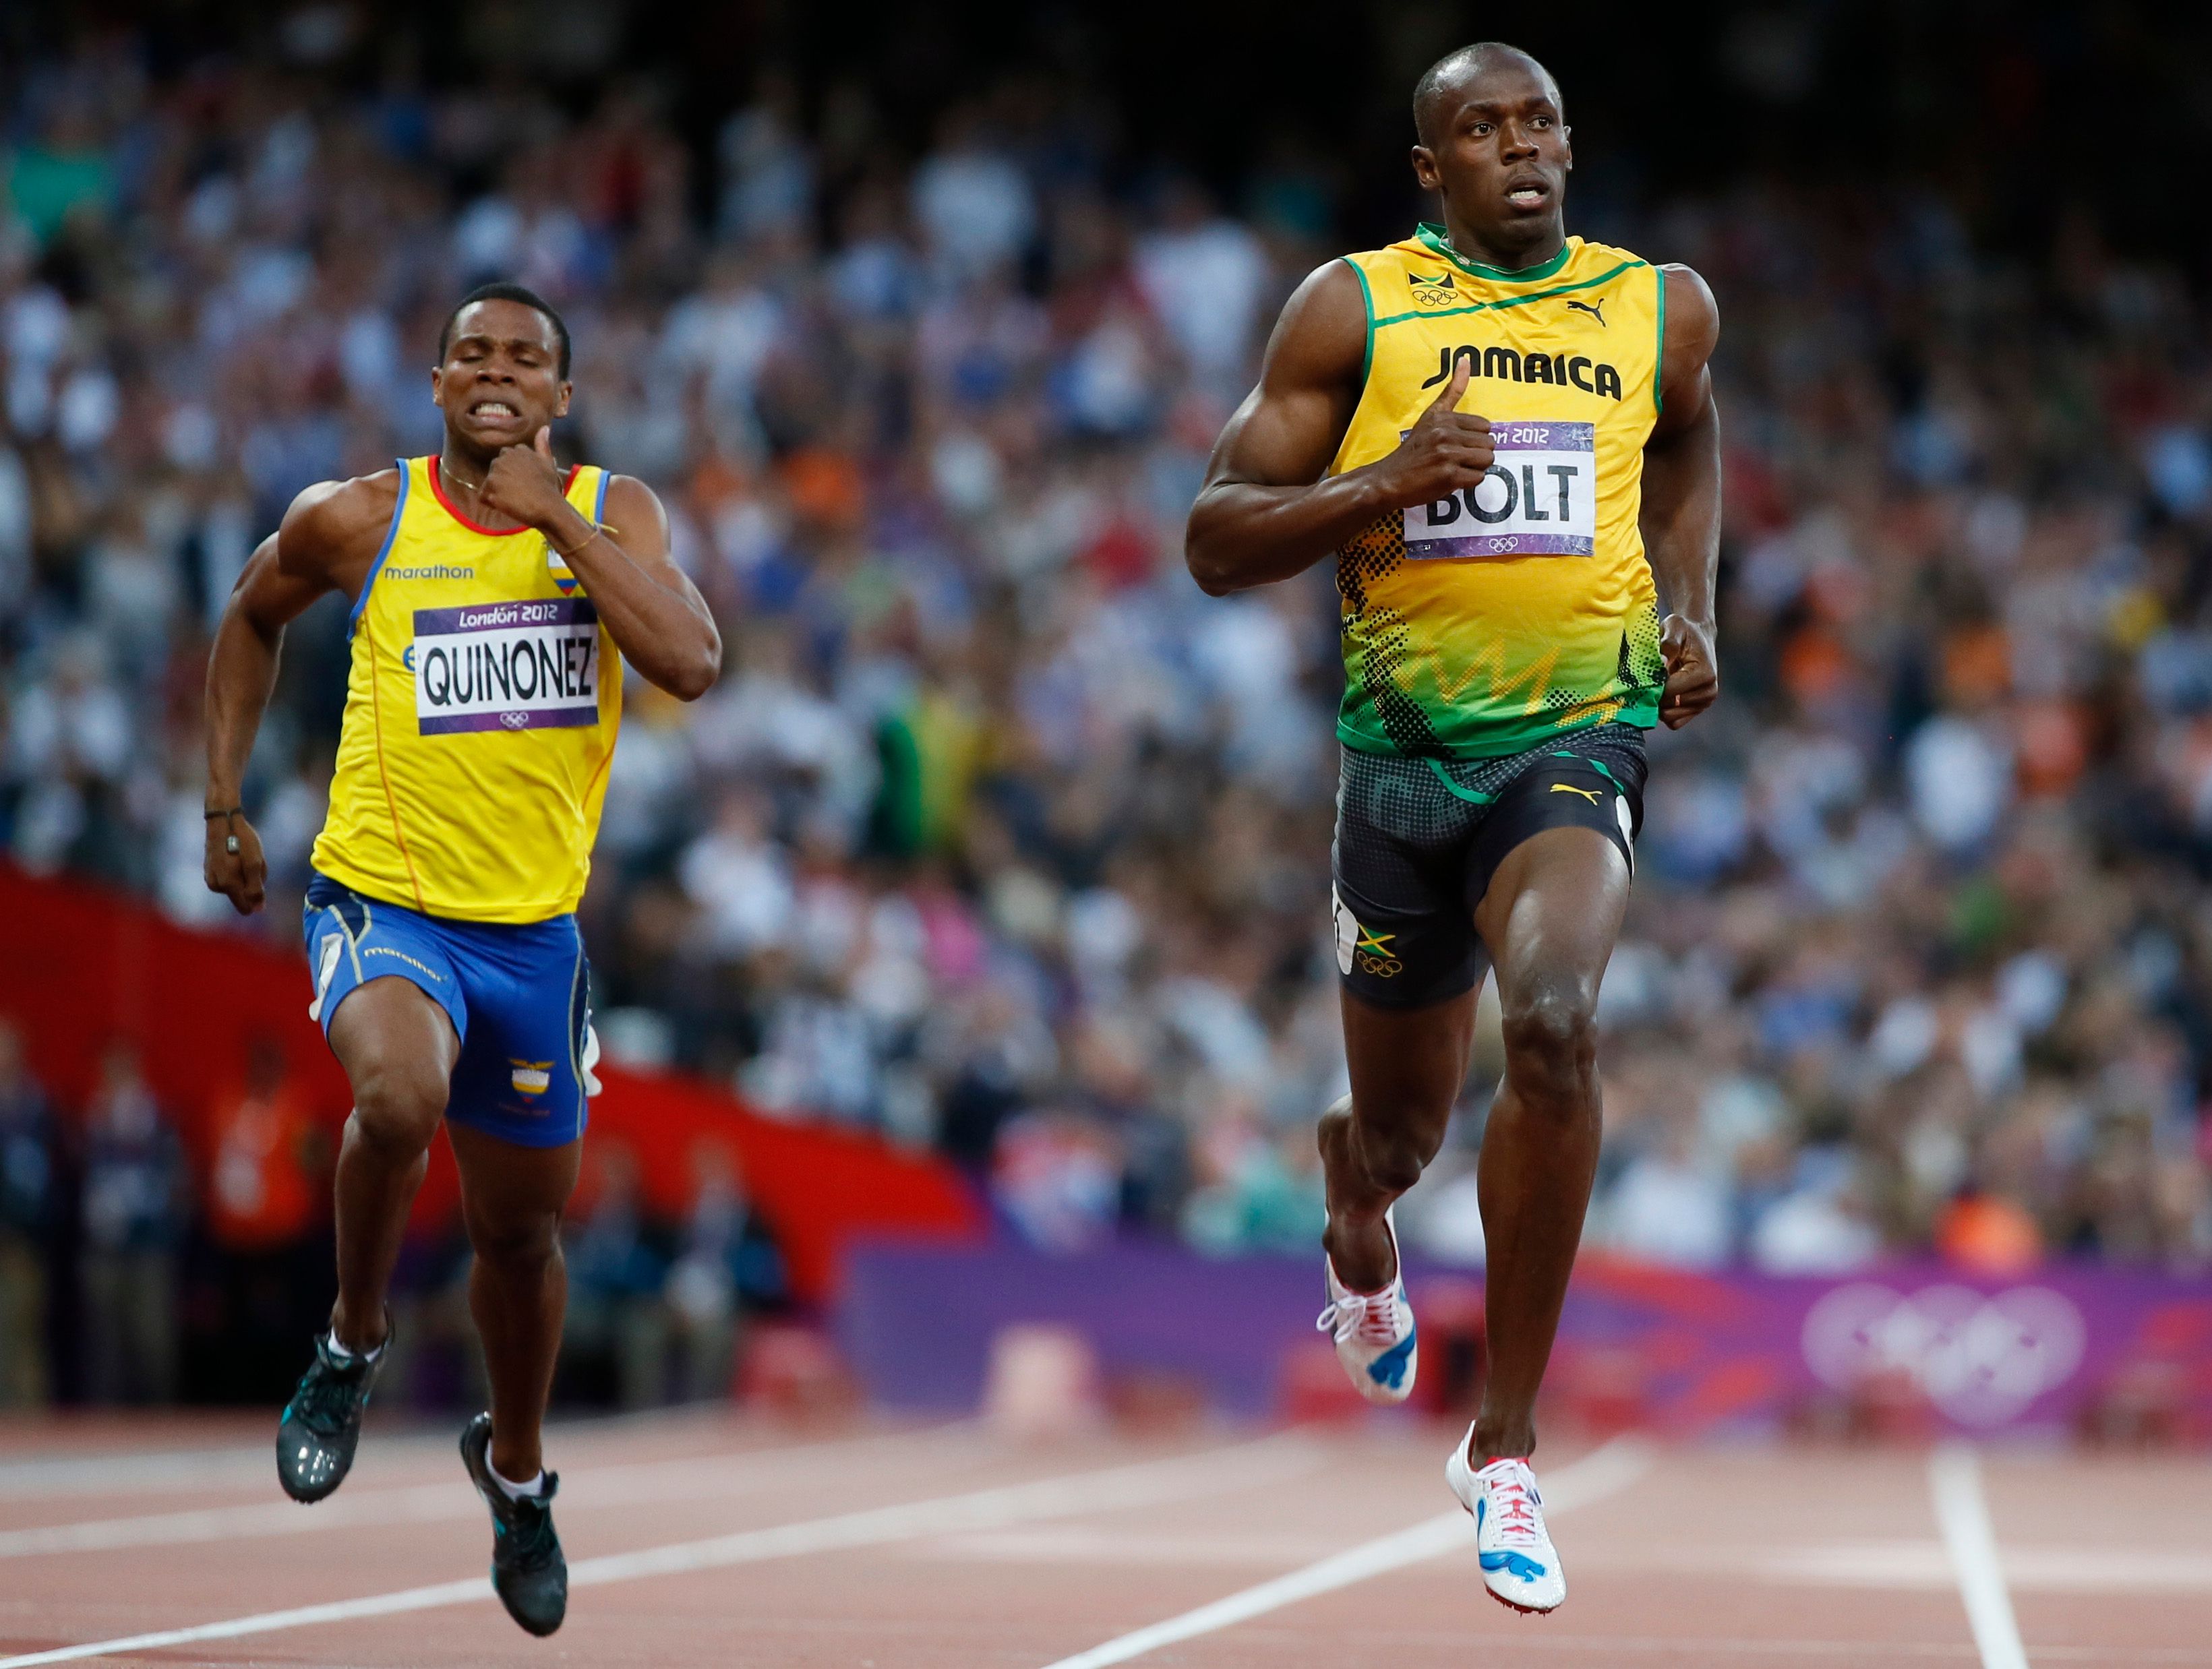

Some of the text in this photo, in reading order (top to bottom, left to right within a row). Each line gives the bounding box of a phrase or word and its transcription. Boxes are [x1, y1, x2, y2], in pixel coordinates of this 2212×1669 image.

[1421, 344, 1621, 402] JAMAICA
[1512, 427, 1549, 444] 2012
[384, 564, 475, 580] marathon
[459, 604, 558, 628] London 2012
[423, 637, 593, 706] QUINONEZ
